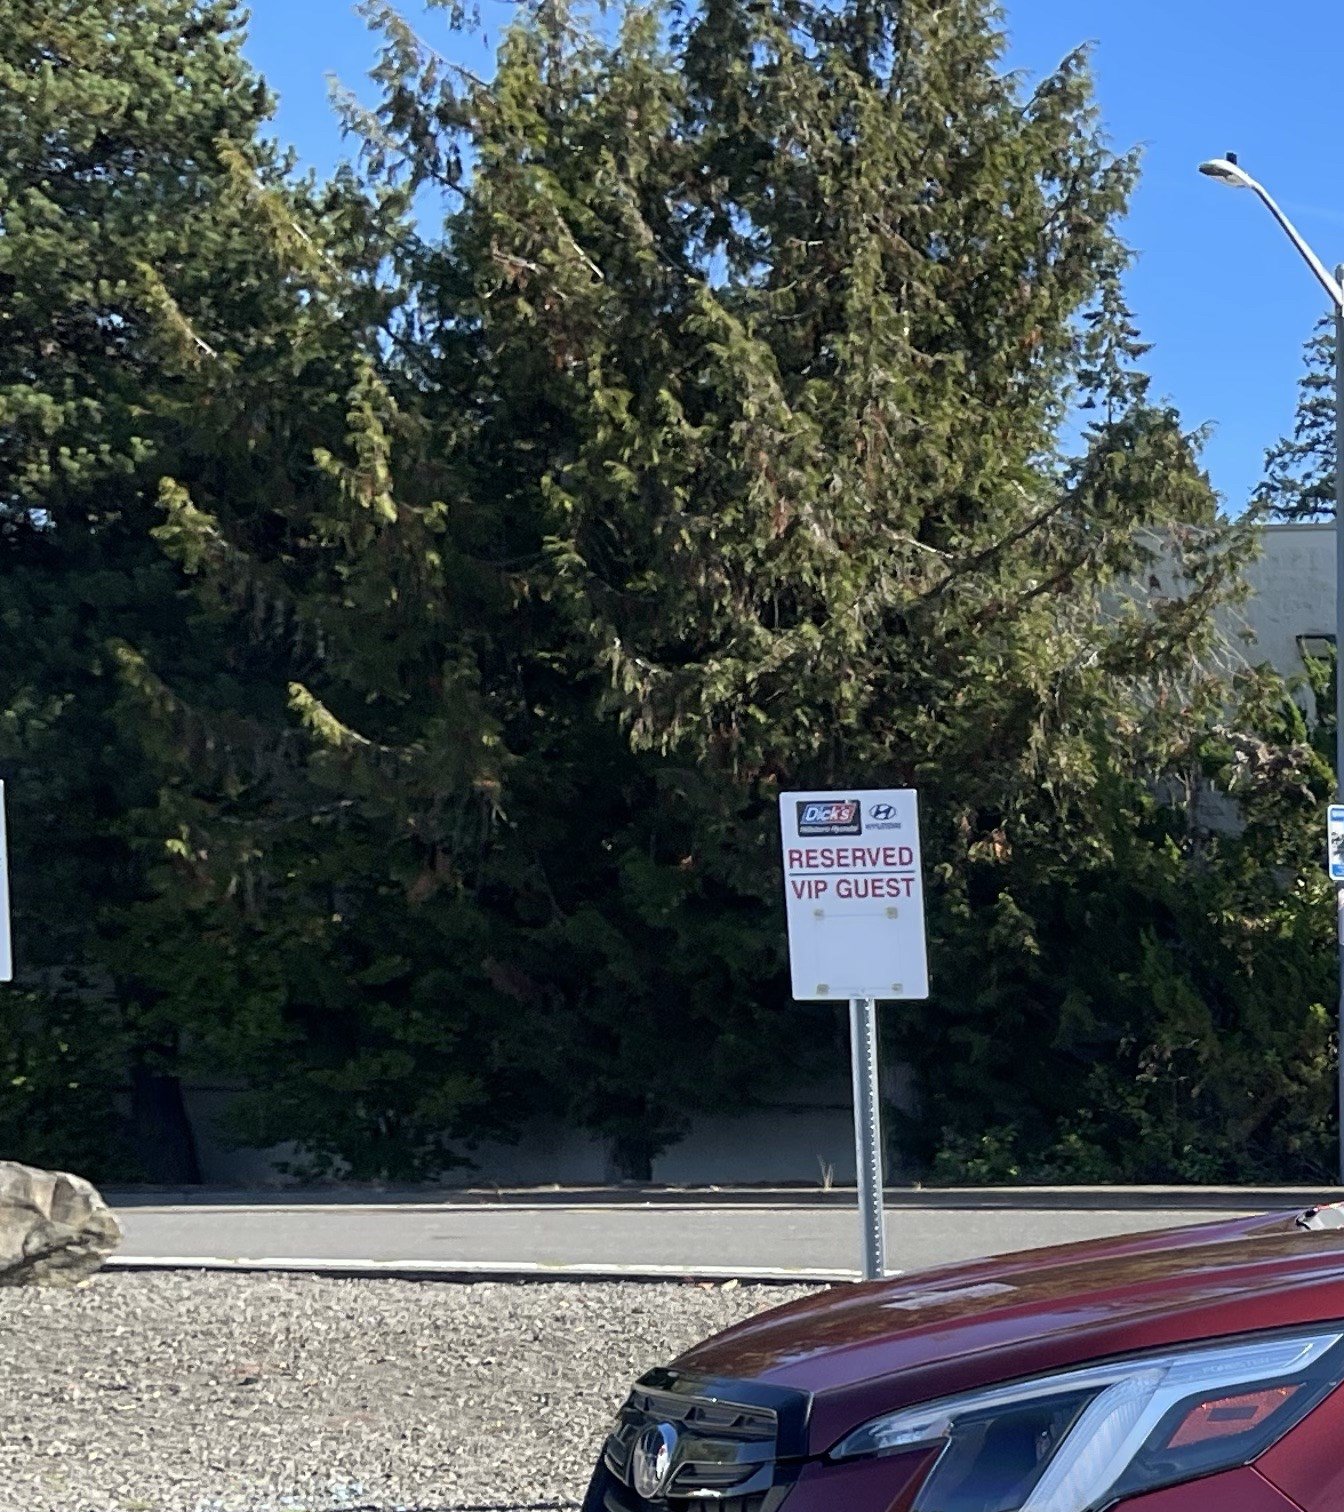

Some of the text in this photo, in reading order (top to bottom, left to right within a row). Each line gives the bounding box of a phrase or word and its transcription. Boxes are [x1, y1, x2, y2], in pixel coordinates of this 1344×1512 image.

[788, 846, 914, 869] RESERVED
[791, 877, 916, 900] VIP GUEST
